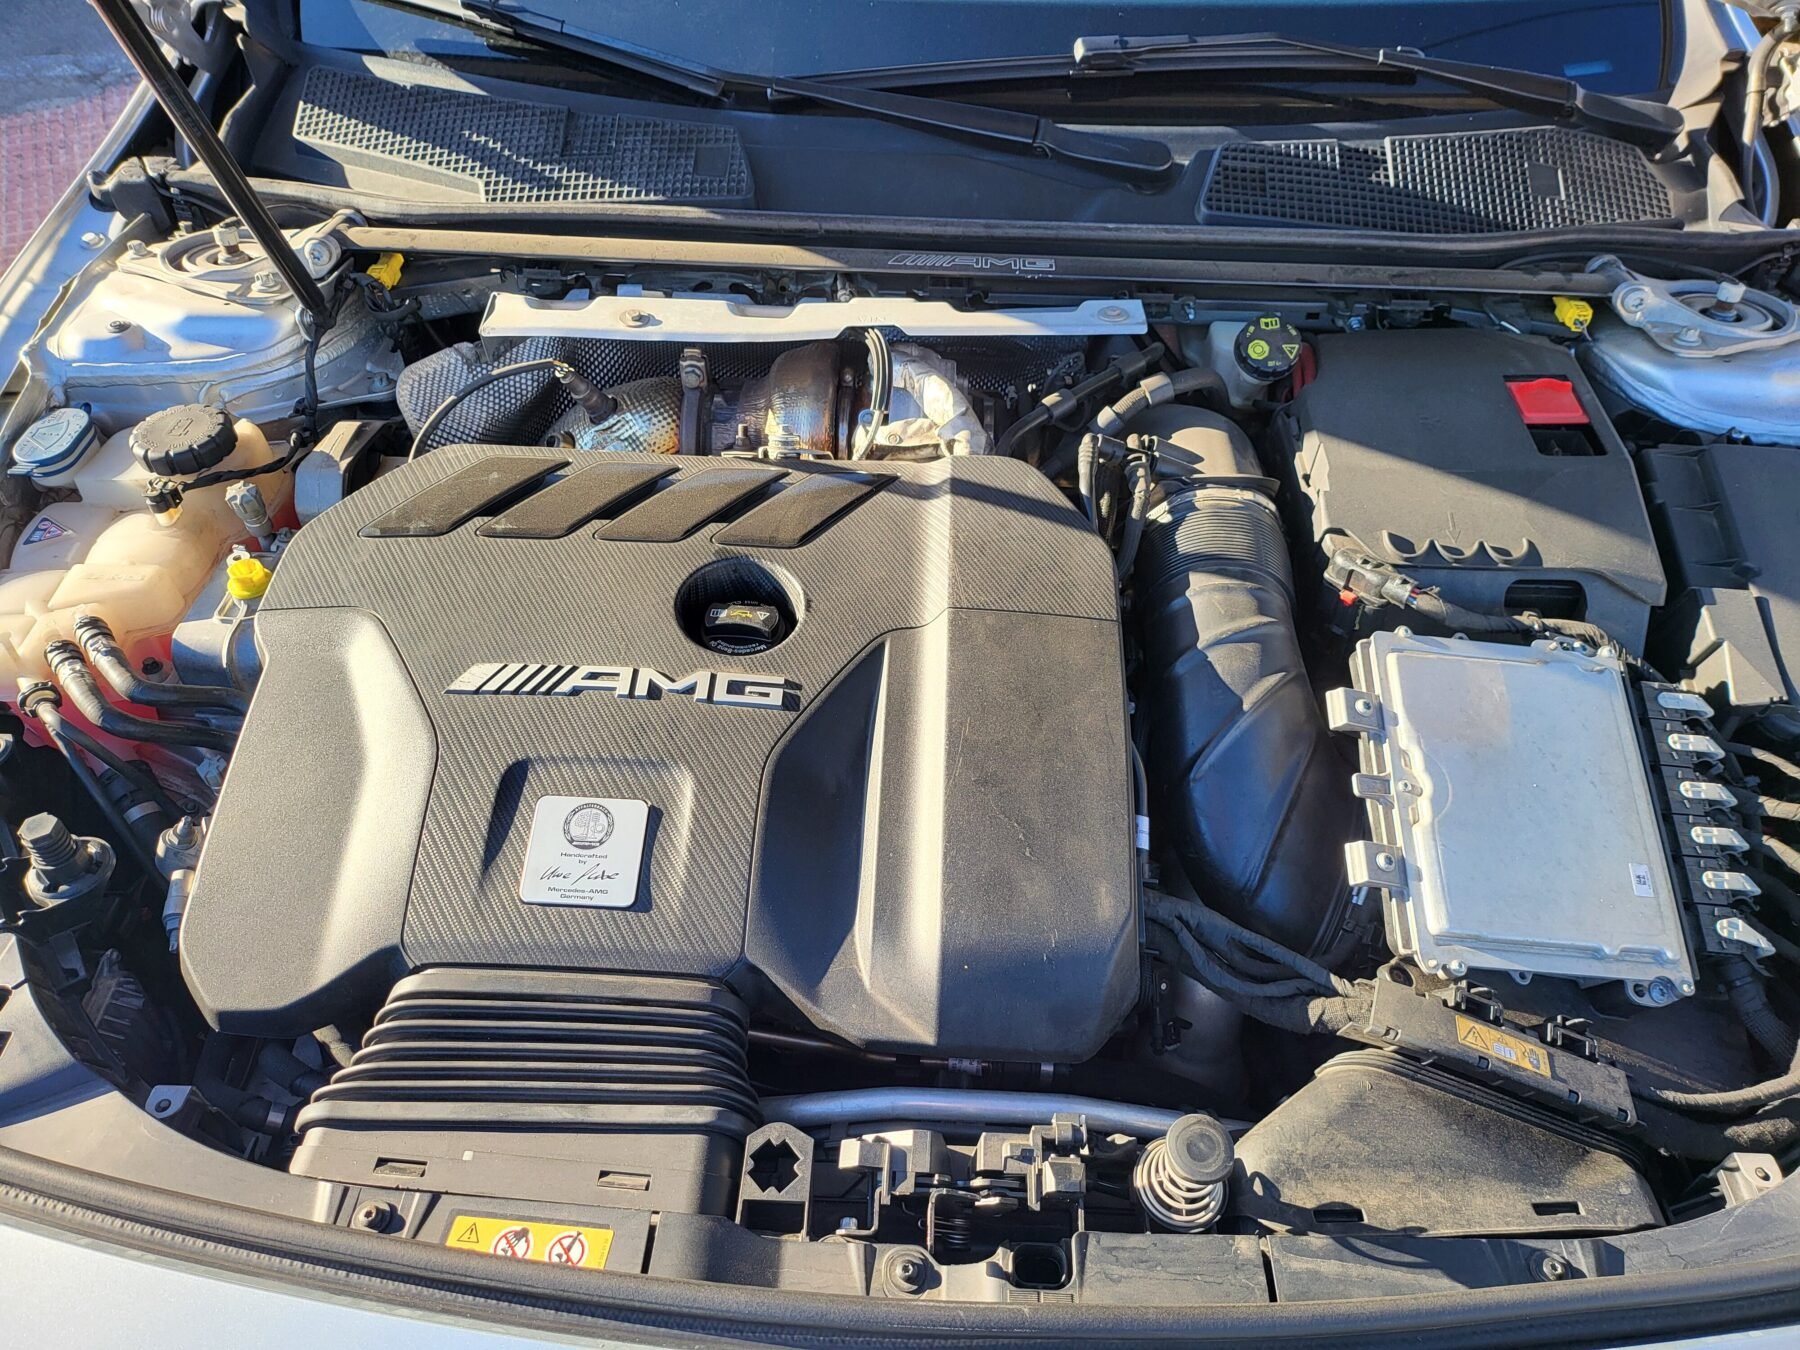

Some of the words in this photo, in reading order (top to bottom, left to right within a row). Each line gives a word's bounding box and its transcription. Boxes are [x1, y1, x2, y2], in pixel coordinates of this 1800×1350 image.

[943, 255, 1056, 271] AMG
[551, 664, 786, 710] AMG
[560, 851, 608, 859] Handcrafted
[547, 886, 609, 895] Mercedes-AMG
